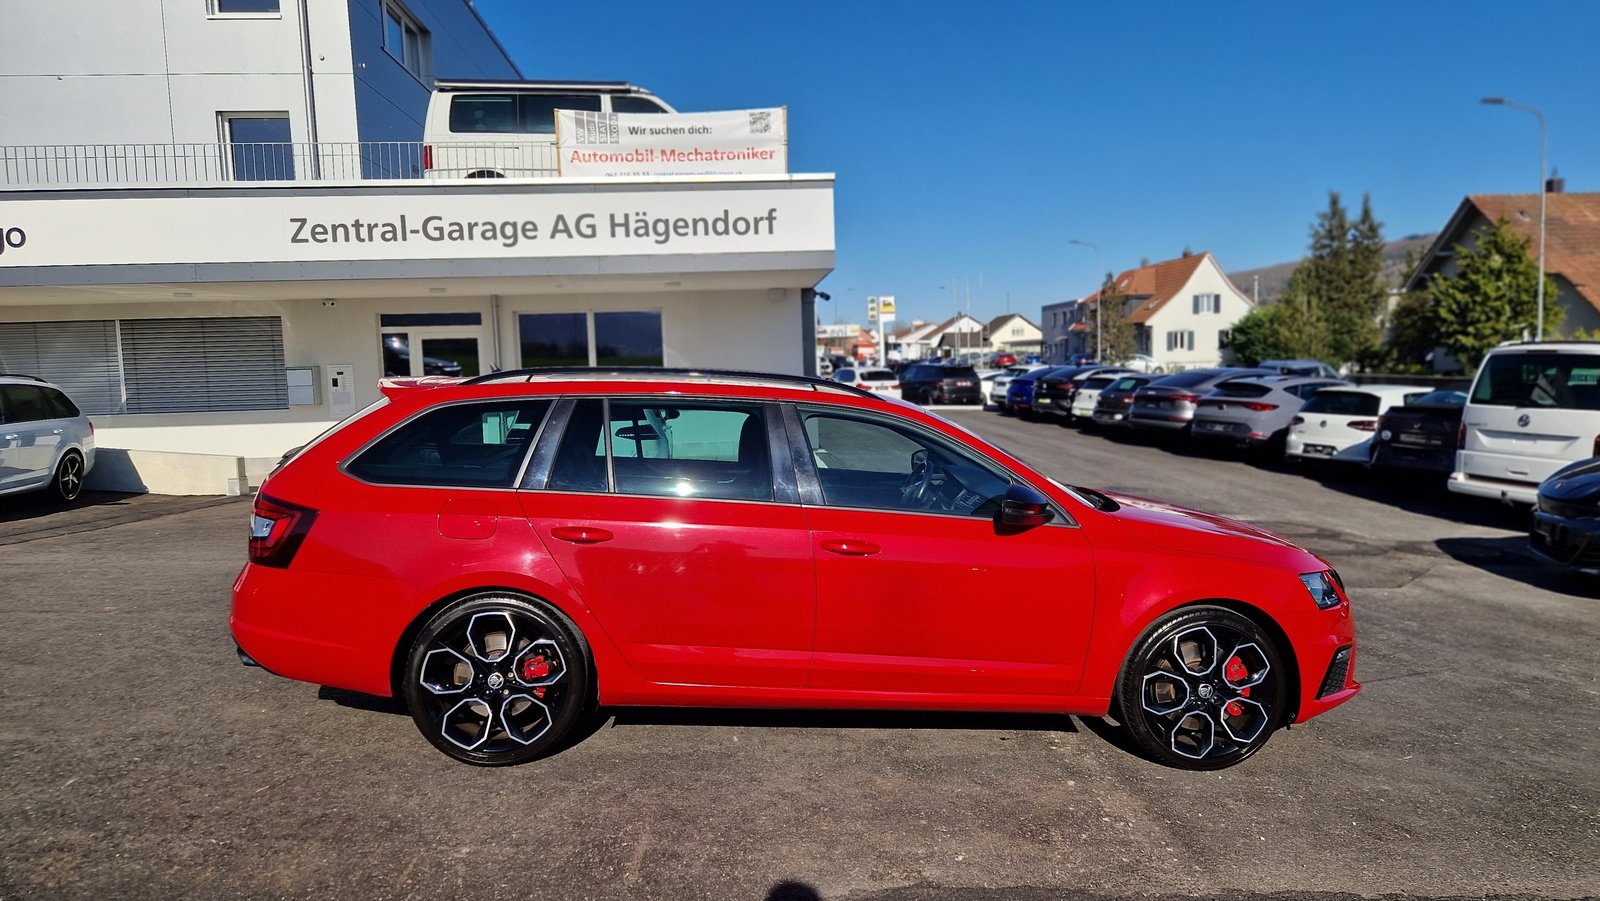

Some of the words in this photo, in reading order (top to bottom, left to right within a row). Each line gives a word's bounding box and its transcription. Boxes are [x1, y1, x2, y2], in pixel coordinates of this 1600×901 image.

[576, 127, 585, 143] VW
[587, 123, 596, 143] Audi
[598, 122, 607, 143] SEAT
[627, 126, 647, 136] Wir
[649, 125, 686, 136] suchen
[687, 125, 713, 135] dich:
[570, 146, 776, 164] Automobil-Mechatroniker
[289, 214, 539, 248] Zentral-Garage
[549, 213, 597, 240] AG
[609, 208, 777, 245] Hägendorf
